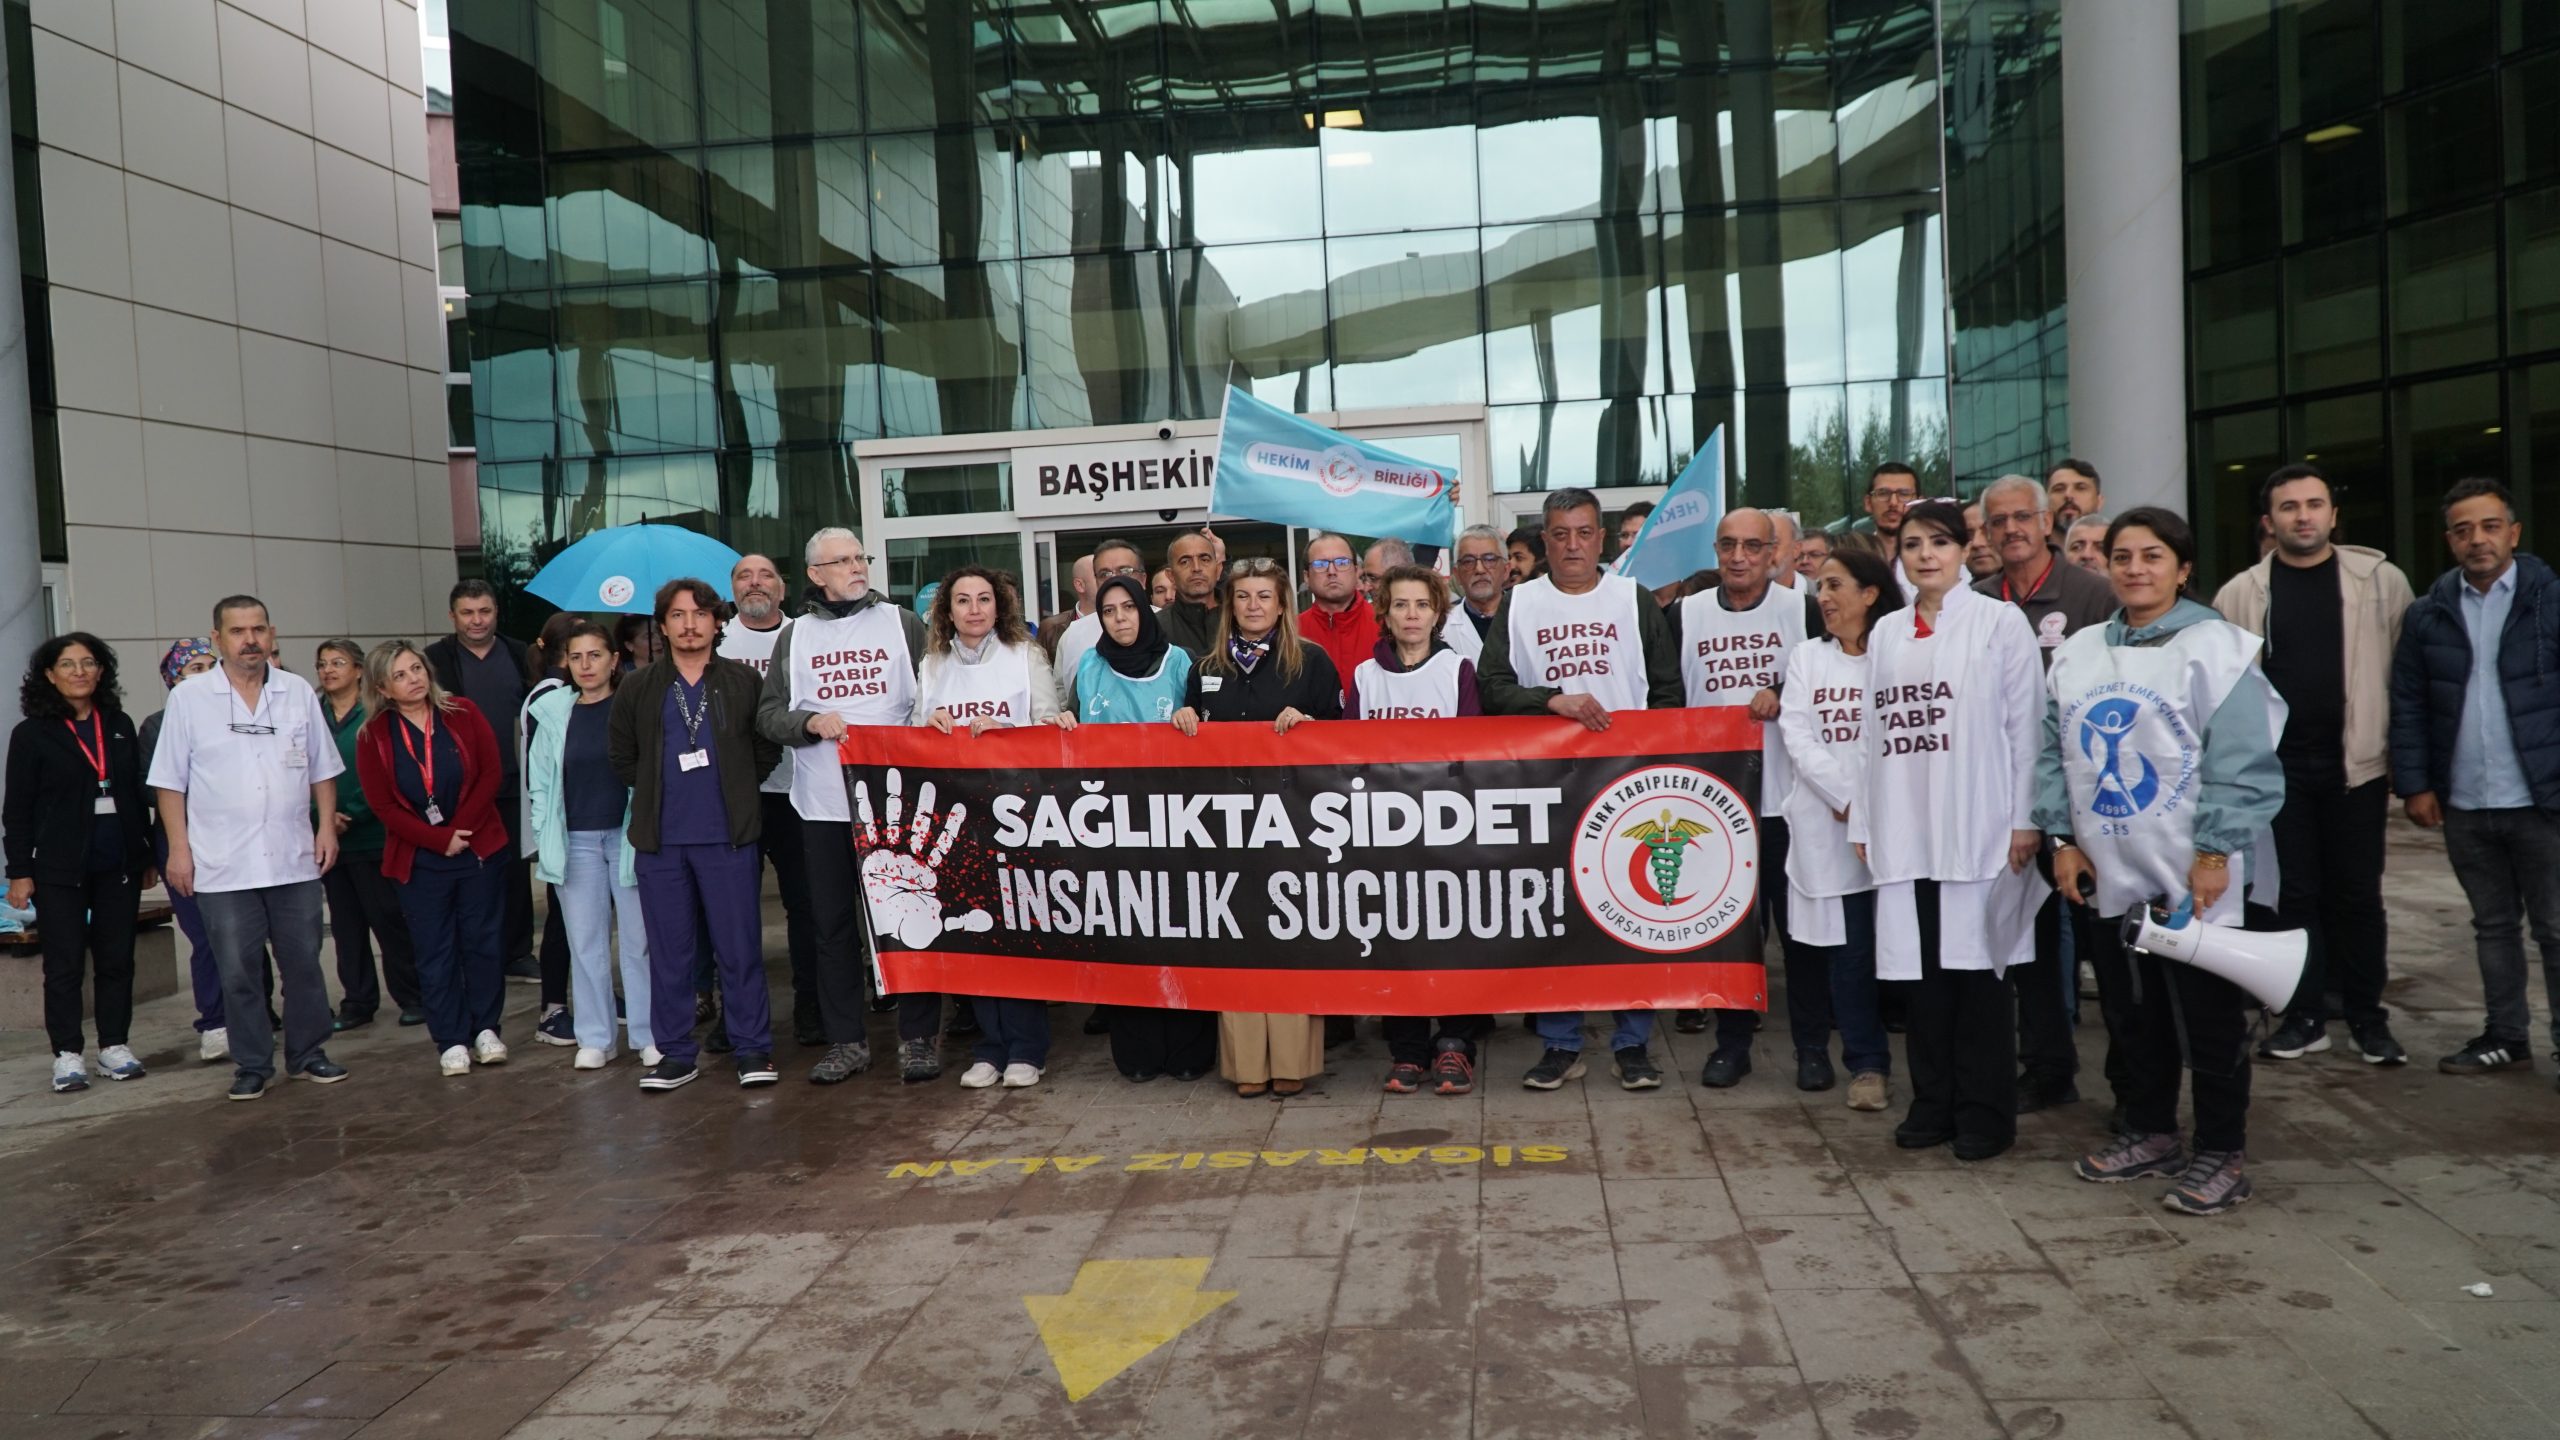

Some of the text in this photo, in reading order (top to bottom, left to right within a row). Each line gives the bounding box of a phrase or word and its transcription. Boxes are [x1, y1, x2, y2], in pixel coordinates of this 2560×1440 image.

[1256, 450, 1310, 472] HEKİM
[1374, 467, 1429, 489] BİRLİĞİ
[1536, 622, 1619, 646] BURSA
[1697, 631, 1783, 657] BURSA
[810, 648, 889, 669] BURSA
[1545, 639, 1610, 662] TABİP
[818, 665, 883, 684] TABİP
[1704, 652, 1775, 674] TABİP
[817, 680, 888, 700] ODASI
[1705, 671, 1780, 693] ODASI
[1875, 681, 1955, 710] BURSA
[936, 701, 1011, 720] URSA
[1880, 704, 1947, 731] TABİP
[1584, 774, 1752, 840] TÜRK TABİPLERİ BİRLİĞİ
[2099, 802, 2129, 816] 1996
[992, 776, 1562, 864] SAĞLIKTA ŞİDDET
[2102, 823, 2130, 836] SES
[996, 852, 1566, 958] İNSANLIK SUÇUDUR!
[1597, 895, 1741, 943] BURSA TABİP ODASI
[886, 1144, 1569, 1180] SİGARASIZ ALAN
